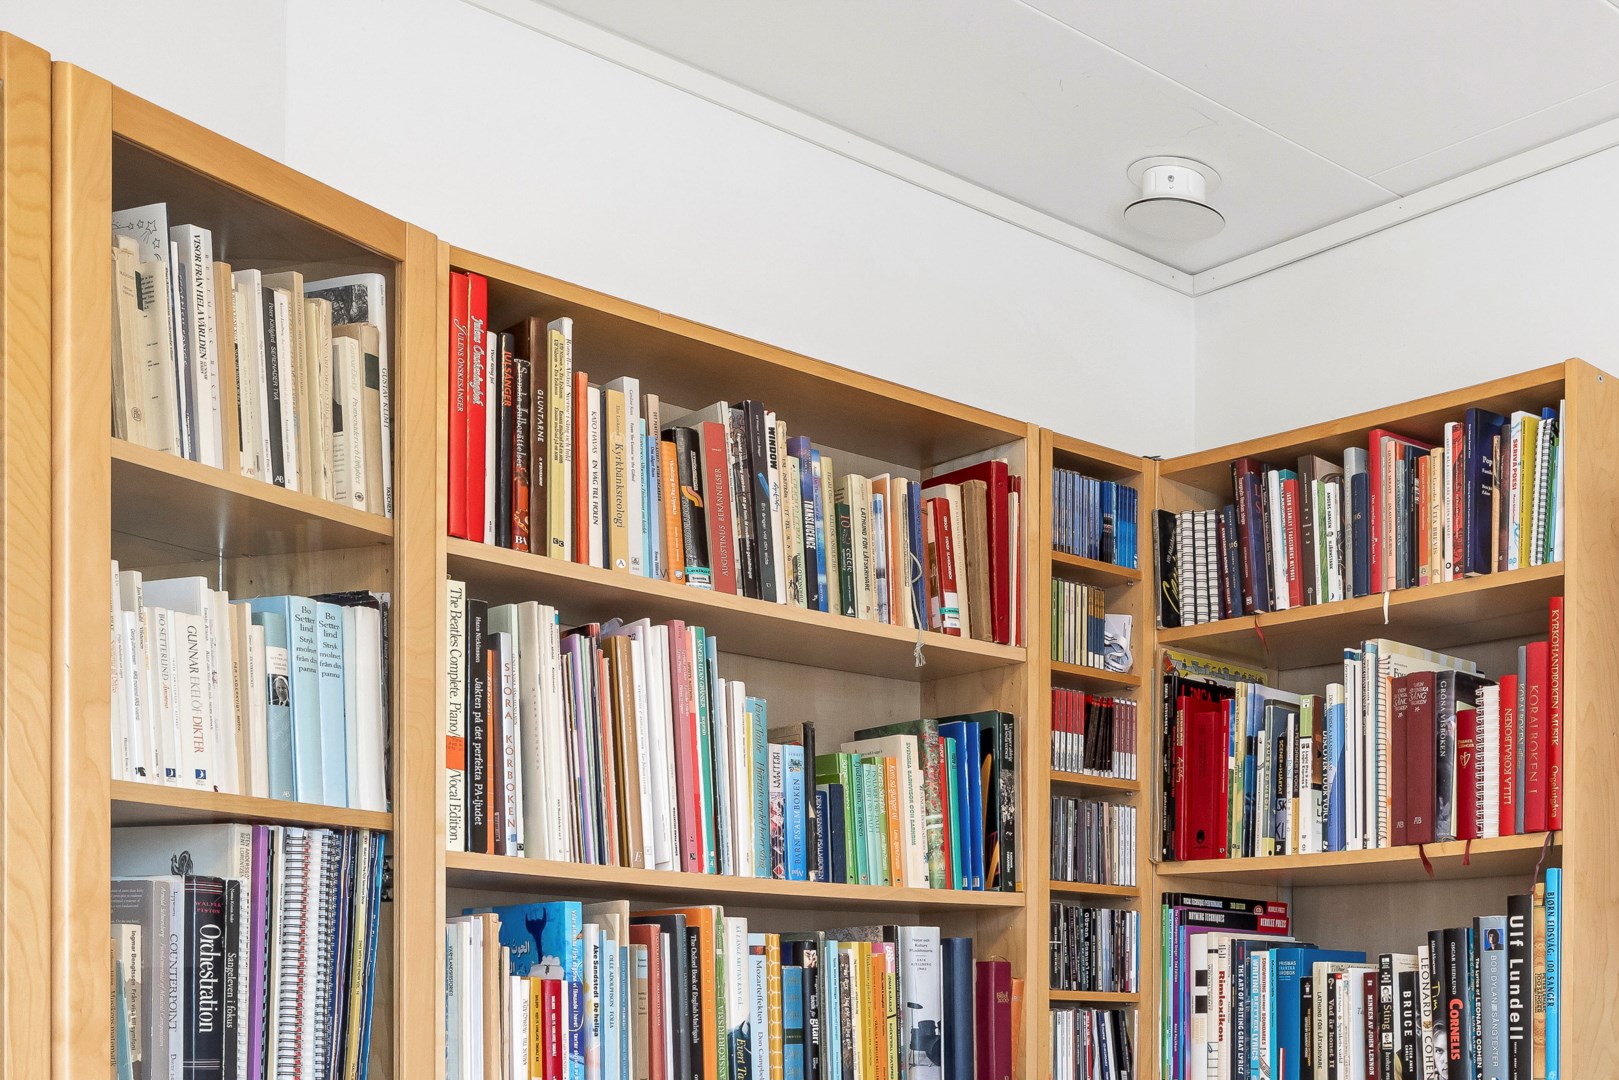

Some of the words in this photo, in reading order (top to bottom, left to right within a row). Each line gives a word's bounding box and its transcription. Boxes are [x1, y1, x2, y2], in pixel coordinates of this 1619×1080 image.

[194, 234, 202, 262] VISOR
[195, 263, 205, 288] FRÅN
[197, 290, 205, 316] HELA
[199, 317, 208, 359] VÄRLDEN
[269, 345, 278, 386] SERENADER
[381, 367, 389, 401] GUSTAV
[504, 351, 513, 406] JULSÅNGER
[382, 402, 390, 431] KLIMT
[592, 460, 598, 469] EN
[768, 427, 777, 469] WINDOW
[614, 443, 625, 528] Kyrkbänksteologi
[714, 468, 725, 522] BEKÄNNELSER
[804, 500, 816, 550] TRANSLUCENCE
[718, 525, 729, 577] AUGUSTINUS
[862, 551, 870, 591] LÅTSKRIVARE
[450, 588, 462, 608] The
[158, 613, 167, 626] BO
[324, 630, 337, 638] lind
[449, 610, 462, 647] Beatles
[159, 627, 169, 681] SETTERLIND
[186, 625, 199, 674] GUNNAR
[1551, 609, 1560, 709] KYRKOHANDBOKEN
[447, 649, 462, 699] Complete.
[504, 663, 512, 720] STORA
[187, 676, 202, 715] EKELÖF
[474, 678, 483, 710] Jakten
[1440, 680, 1448, 711] GRÖNA
[192, 716, 204, 753] DIKTER
[449, 702, 462, 735] Piano/
[473, 712, 483, 723] på
[474, 726, 483, 740] det
[1528, 685, 1539, 782] KORALBOKEN
[1551, 713, 1559, 747] MUSIK
[1504, 708, 1513, 775] KORALBOKEN
[473, 742, 483, 780] perfekta
[772, 752, 781, 788] BELLMAN
[505, 735, 517, 828] KÖRBOKEN
[1504, 777, 1512, 804] LILLA
[473, 783, 484, 825] PA-ljudet
[793, 779, 801, 864] BARNPSALMBOKEN
[448, 804, 462, 844] Edition.
[1546, 892, 1555, 917] BJØRN
[1509, 916, 1524, 947] Ulf
[1547, 920, 1556, 957] EIDSVÅG:
[168, 933, 179, 1033] COUNTERPOINT
[198, 923, 221, 1033] Orchestration
[225, 952, 237, 999] Sangeleven
[755, 960, 764, 1024] Mozarteffekten
[1421, 958, 1431, 1017] LEONARD
[1547, 976, 1555, 1007] SANGER
[593, 1003, 599, 1013] De
[690, 992, 699, 1014] English
[1403, 991, 1412, 1037] BRUCE
[1431, 981, 1440, 1011] Tim
[1509, 958, 1524, 1040] Lundell
[226, 1005, 237, 1028] fokus
[592, 1014, 600, 1037] heliga
[691, 1015, 699, 1043] Madrigals
[1329, 1019, 1334, 1029] är
[1368, 1019, 1374, 1029] AV
[1382, 1004, 1393, 1029] Sting
[1449, 999, 1463, 1060] CORNELIS
[736, 1038, 746, 1064] Evert
[1424, 1036, 1434, 1080] COHEN
[1492, 1012, 1500, 1067] SÅNGTEXTER
